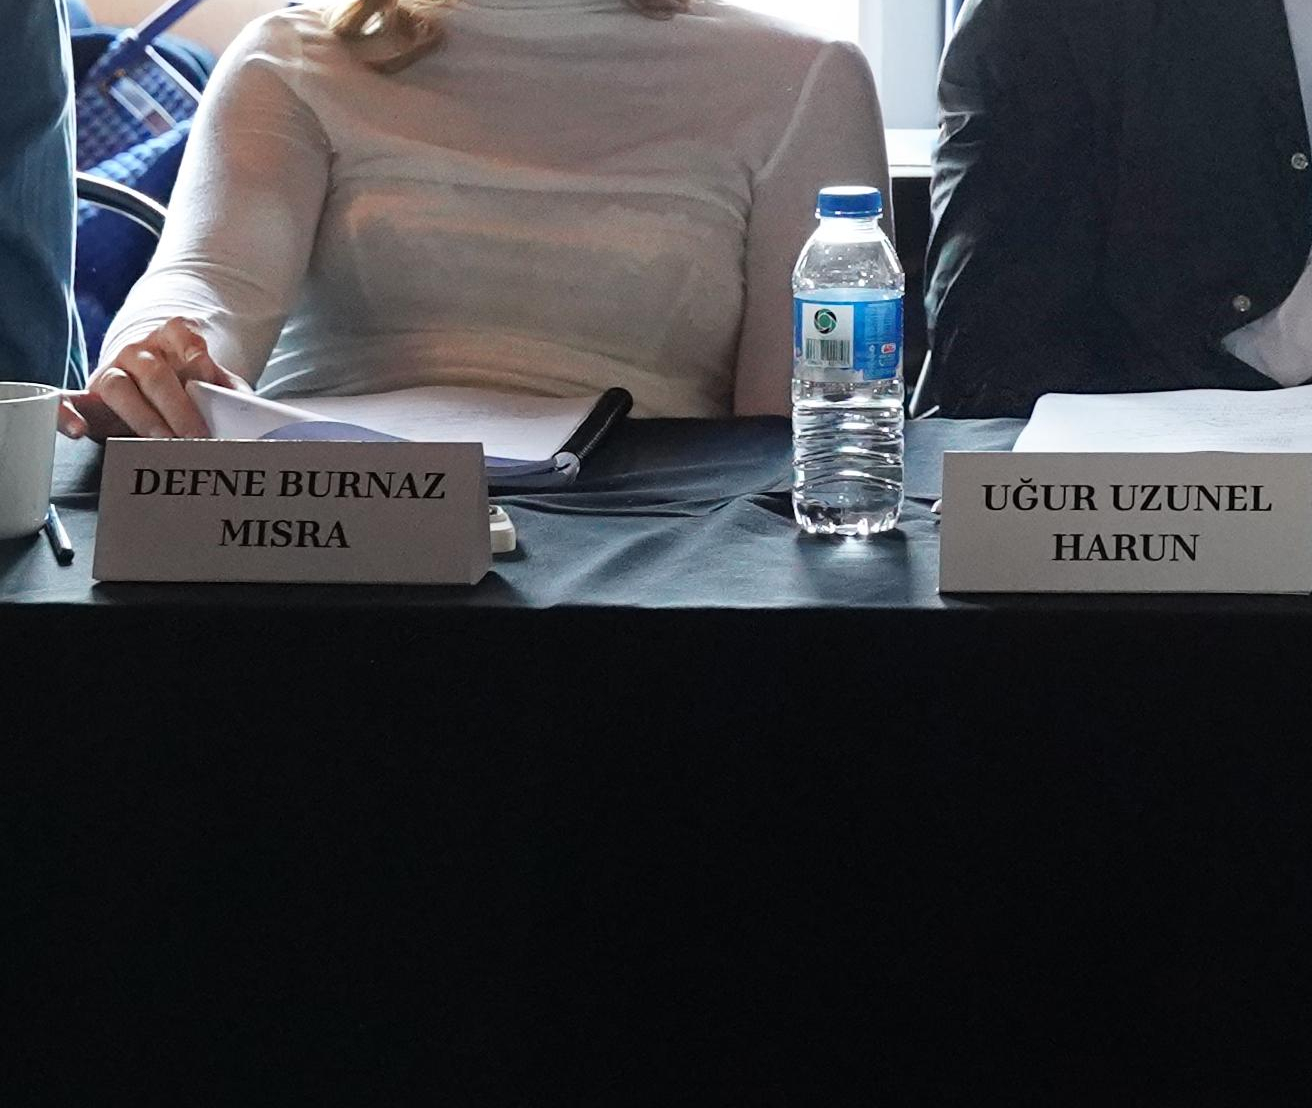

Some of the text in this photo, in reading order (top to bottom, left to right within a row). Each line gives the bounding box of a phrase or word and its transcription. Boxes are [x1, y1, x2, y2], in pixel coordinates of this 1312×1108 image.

[130, 467, 447, 501] DEFNE BURNAZ
[981, 476, 1273, 512] UĞUR UZUNEL
[216, 518, 352, 549] MISRA
[1051, 533, 1201, 563] HARUN
